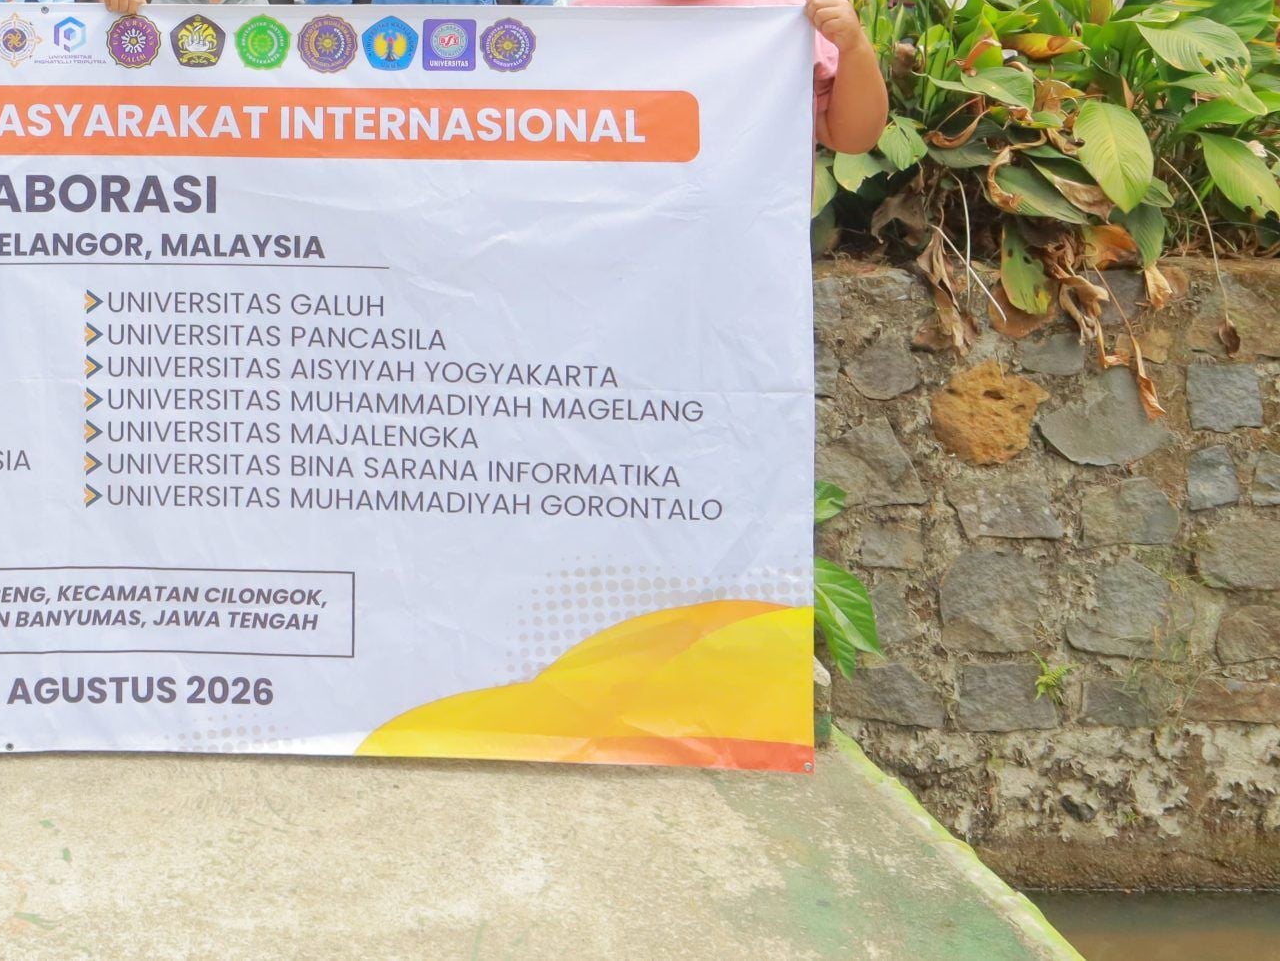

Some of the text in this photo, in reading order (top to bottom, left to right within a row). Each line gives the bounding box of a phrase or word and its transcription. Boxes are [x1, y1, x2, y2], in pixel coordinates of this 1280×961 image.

[112, 19, 155, 46] UNIVERSITAS
[429, 59, 469, 67] UNIVERSITAS
[280, 106, 646, 143] INTERNASIONAL
[161, 234, 326, 259] MALAYSIA
[107, 292, 384, 316] UNIVERSITAS GALUH
[107, 324, 447, 350] UNIVERSITAS PANCASILA
[107, 356, 619, 387] UNIVERSITAS AISYIYAH YOGYAKARTA
[107, 389, 704, 422] UNIVERSITAS MUHAMMADIYAH MAGELANG
[107, 421, 479, 448] UNIVERSITAS MAJALENGKA
[107, 453, 681, 487] UNIVERSITAS BINA SARANA INFORMATIKA
[107, 485, 723, 520] UNIVERSITAS MUHAMMADIYAH GORONTALO
[56, 585, 200, 602] KECAMATAN
[204, 588, 328, 608] CILONGOK,
[14, 609, 147, 628] BANYUMAS,
[152, 610, 221, 627] JAWA
[227, 612, 319, 630] TENGAH
[6, 677, 177, 704] AGUSTUS
[186, 676, 274, 705] 2026
